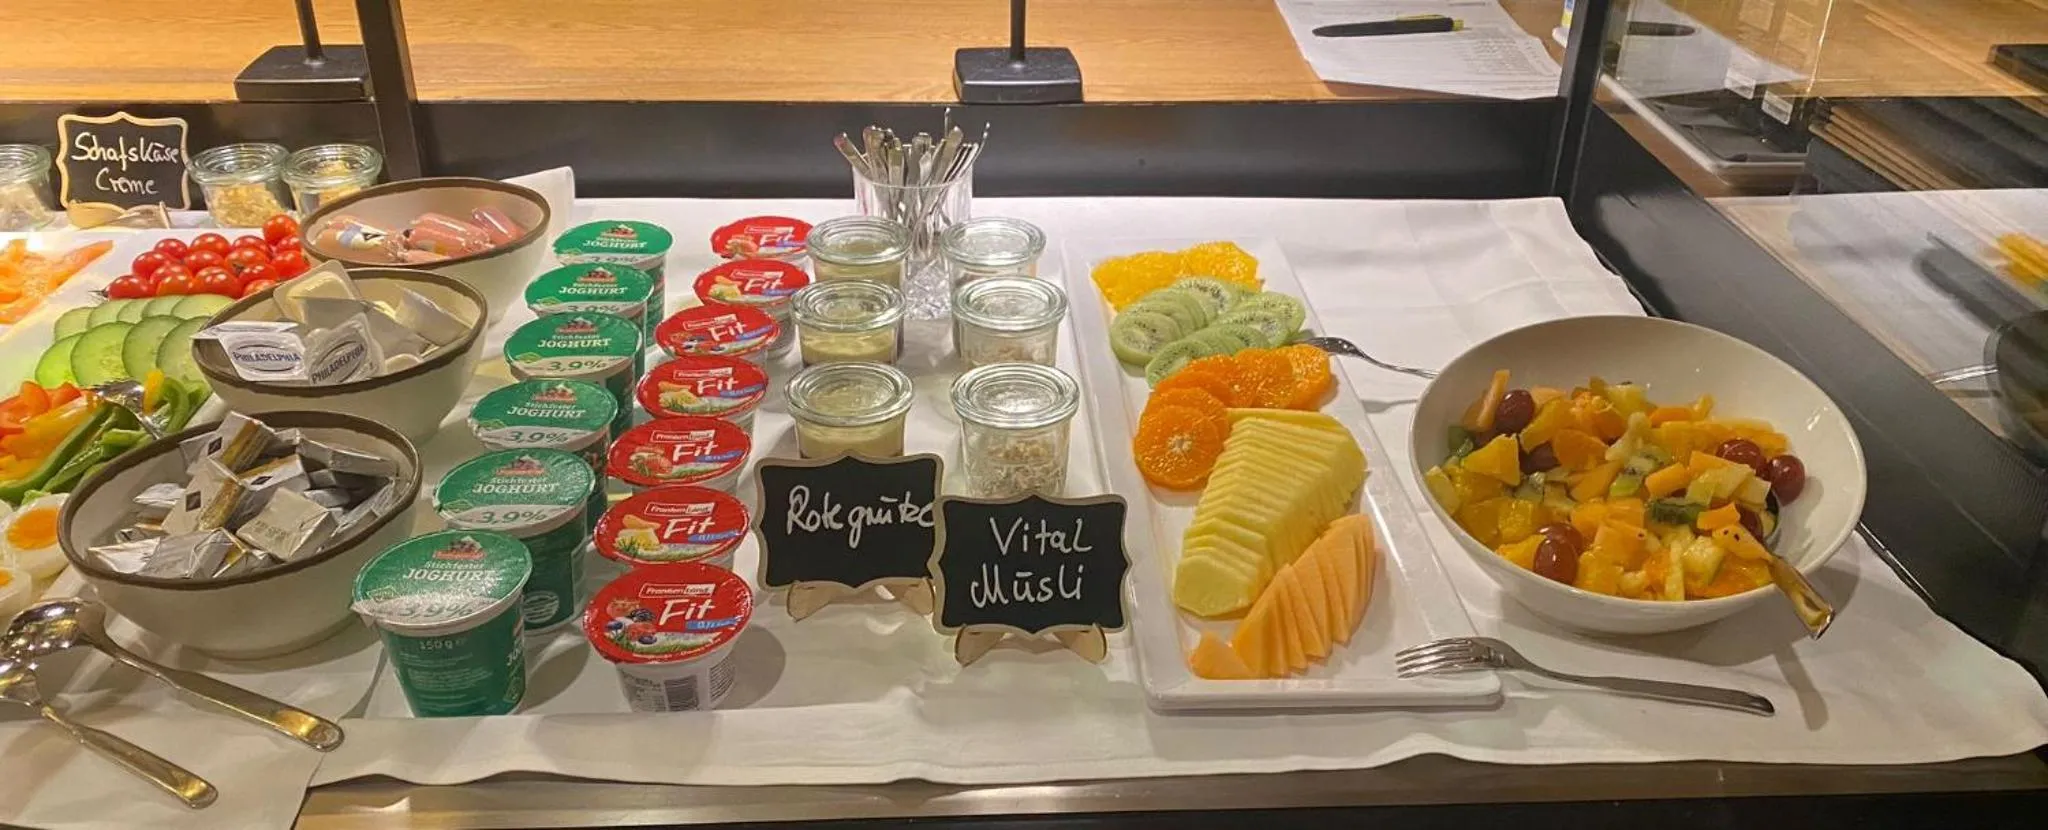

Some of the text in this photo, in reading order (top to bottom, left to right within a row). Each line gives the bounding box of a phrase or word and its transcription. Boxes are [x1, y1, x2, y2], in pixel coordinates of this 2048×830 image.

[96, 167, 159, 194] Creme
[583, 240, 648, 249] JOGHURT
[558, 286, 629, 295] JOGHURT
[744, 277, 784, 292] Fit
[708, 321, 748, 342] Fit
[537, 338, 612, 348] JOGHURT
[232, 350, 302, 363] PHILADELPHIA
[310, 343, 366, 385] PHILADELPHIA
[548, 359, 608, 373] 3,9%
[697, 377, 739, 395] Fit
[506, 406, 587, 418] JOGHURT
[509, 430, 569, 443] 3,9%
[672, 441, 718, 462] Fit
[472, 482, 560, 494] JOGHURT
[480, 510, 548, 524] 3,9%
[662, 516, 716, 539] Fit
[989, 517, 1094, 556] Vital
[402, 566, 504, 582] JOGHURT
[970, 563, 1086, 609] Müsli
[658, 598, 716, 626] Fit
